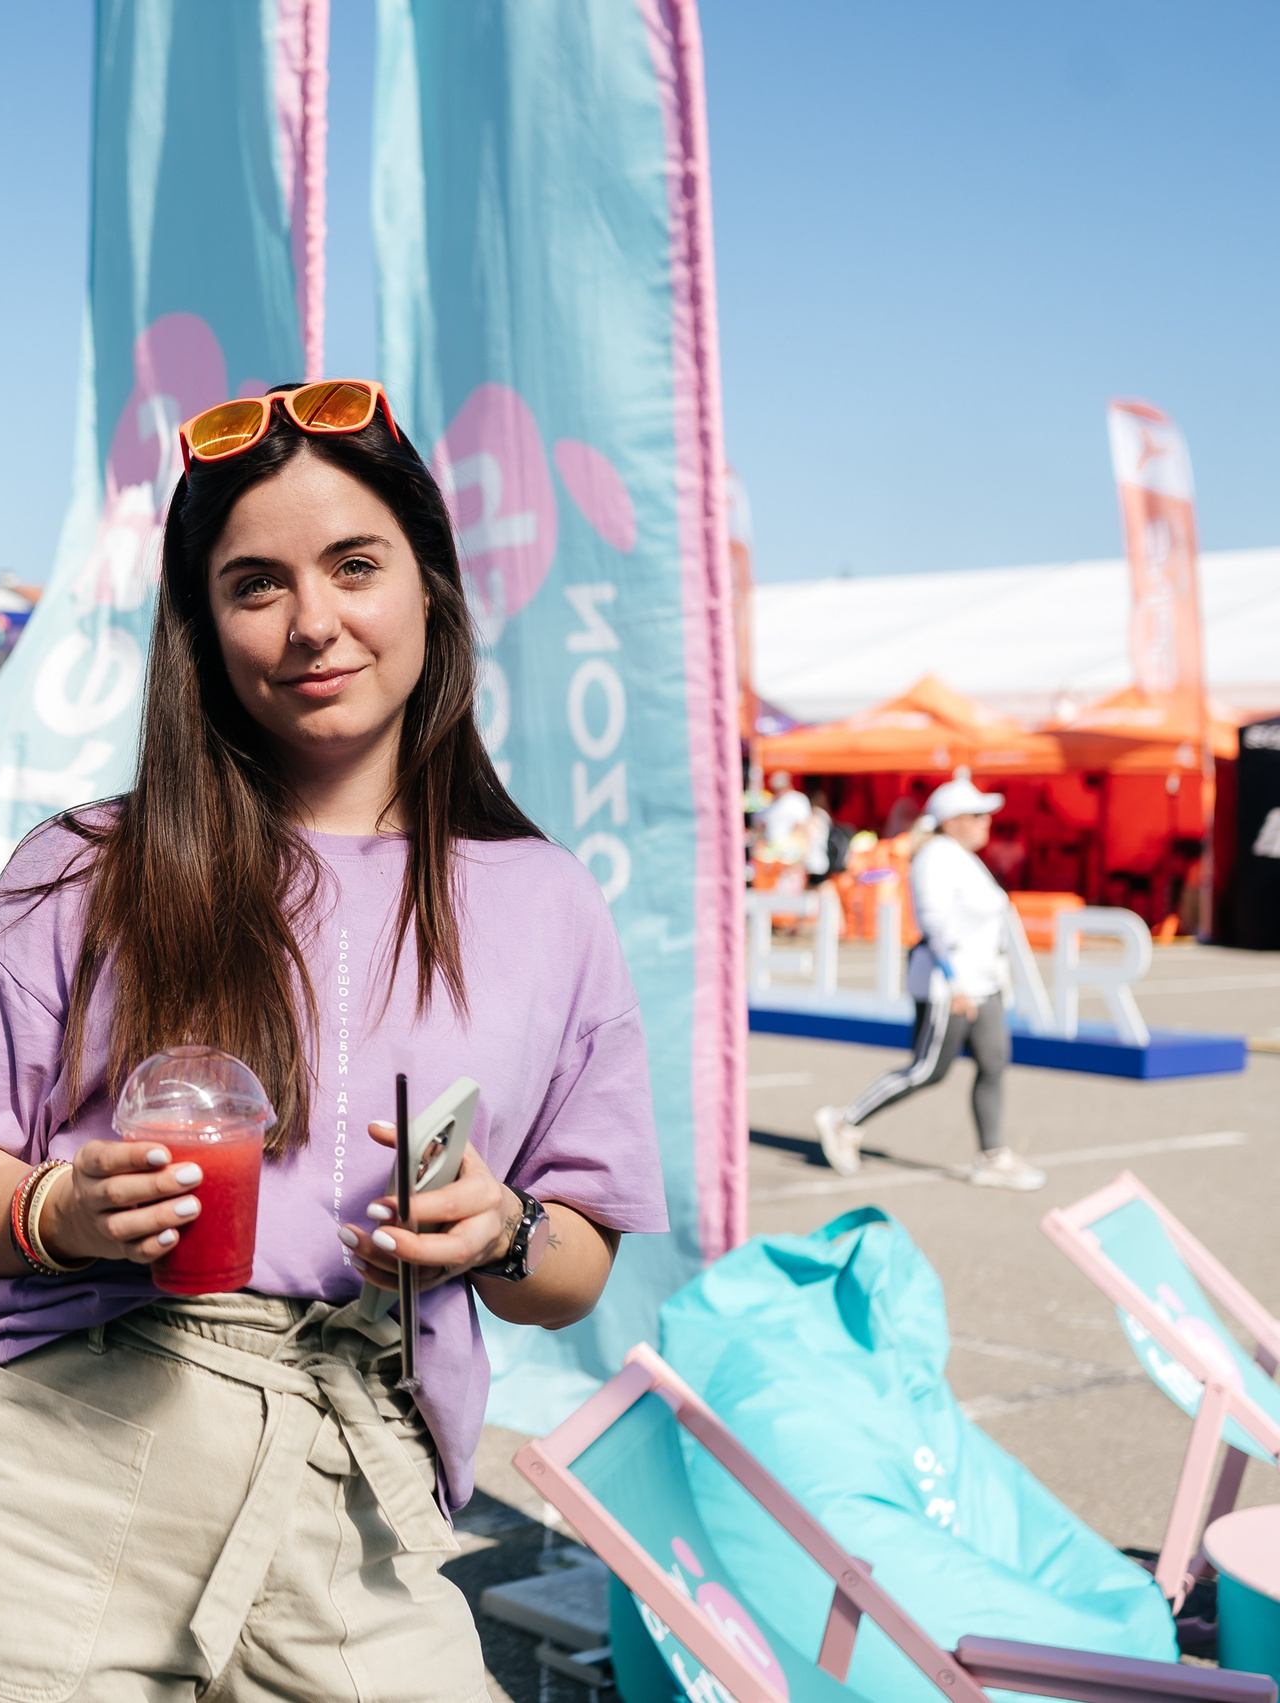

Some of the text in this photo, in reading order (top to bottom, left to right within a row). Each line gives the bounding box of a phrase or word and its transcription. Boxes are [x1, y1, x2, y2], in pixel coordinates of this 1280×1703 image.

[338, 929, 350, 997] ХОРОШО
[339, 1002, 349, 1012] С
[337, 1091, 348, 1115] ДА
[333, 1121, 347, 1183] ПЛОХО
